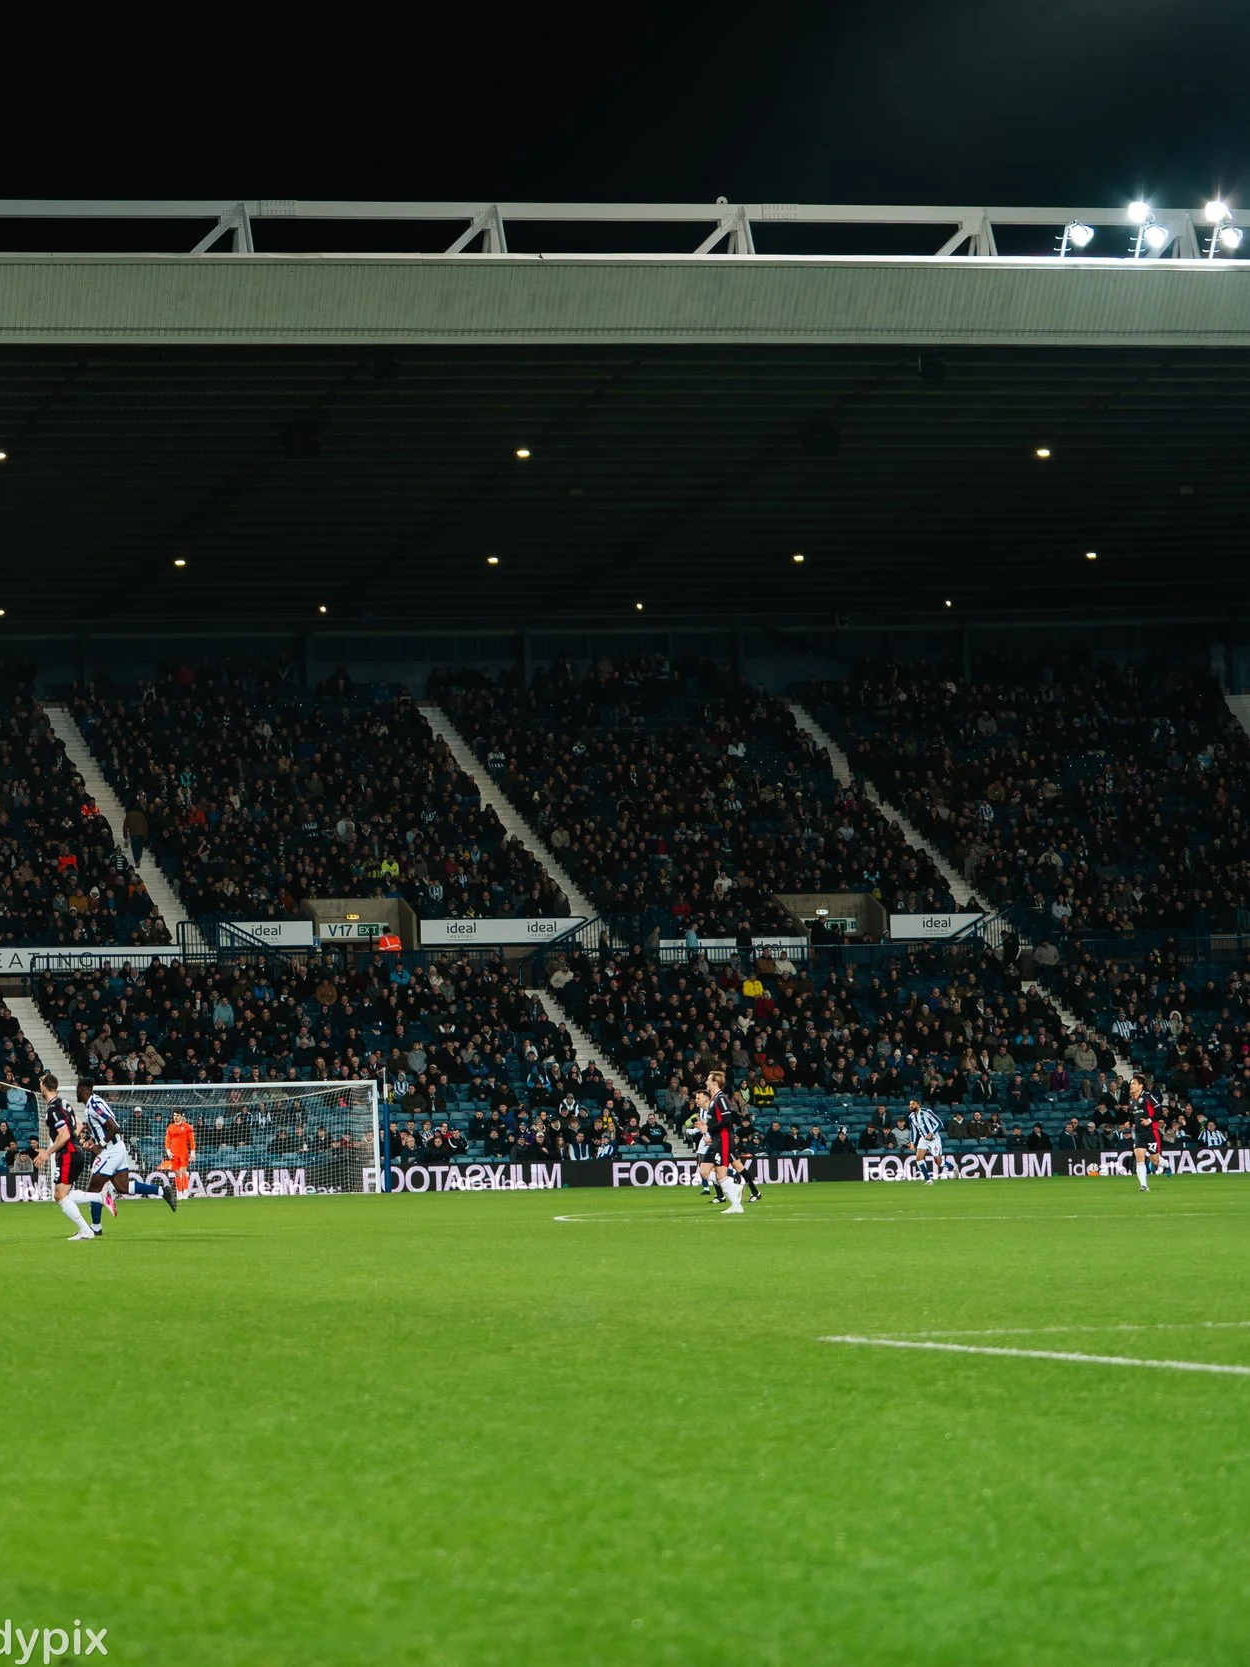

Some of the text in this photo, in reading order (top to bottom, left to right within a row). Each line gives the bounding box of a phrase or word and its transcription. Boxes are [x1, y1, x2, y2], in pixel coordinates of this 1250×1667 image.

[446, 922, 476, 934] ideal
[527, 921, 556, 933] ideal
[922, 917, 951, 928] ideal
[252, 924, 281, 936] ideal
[328, 925, 352, 937] V17
[358, 926, 378, 935] EXT
